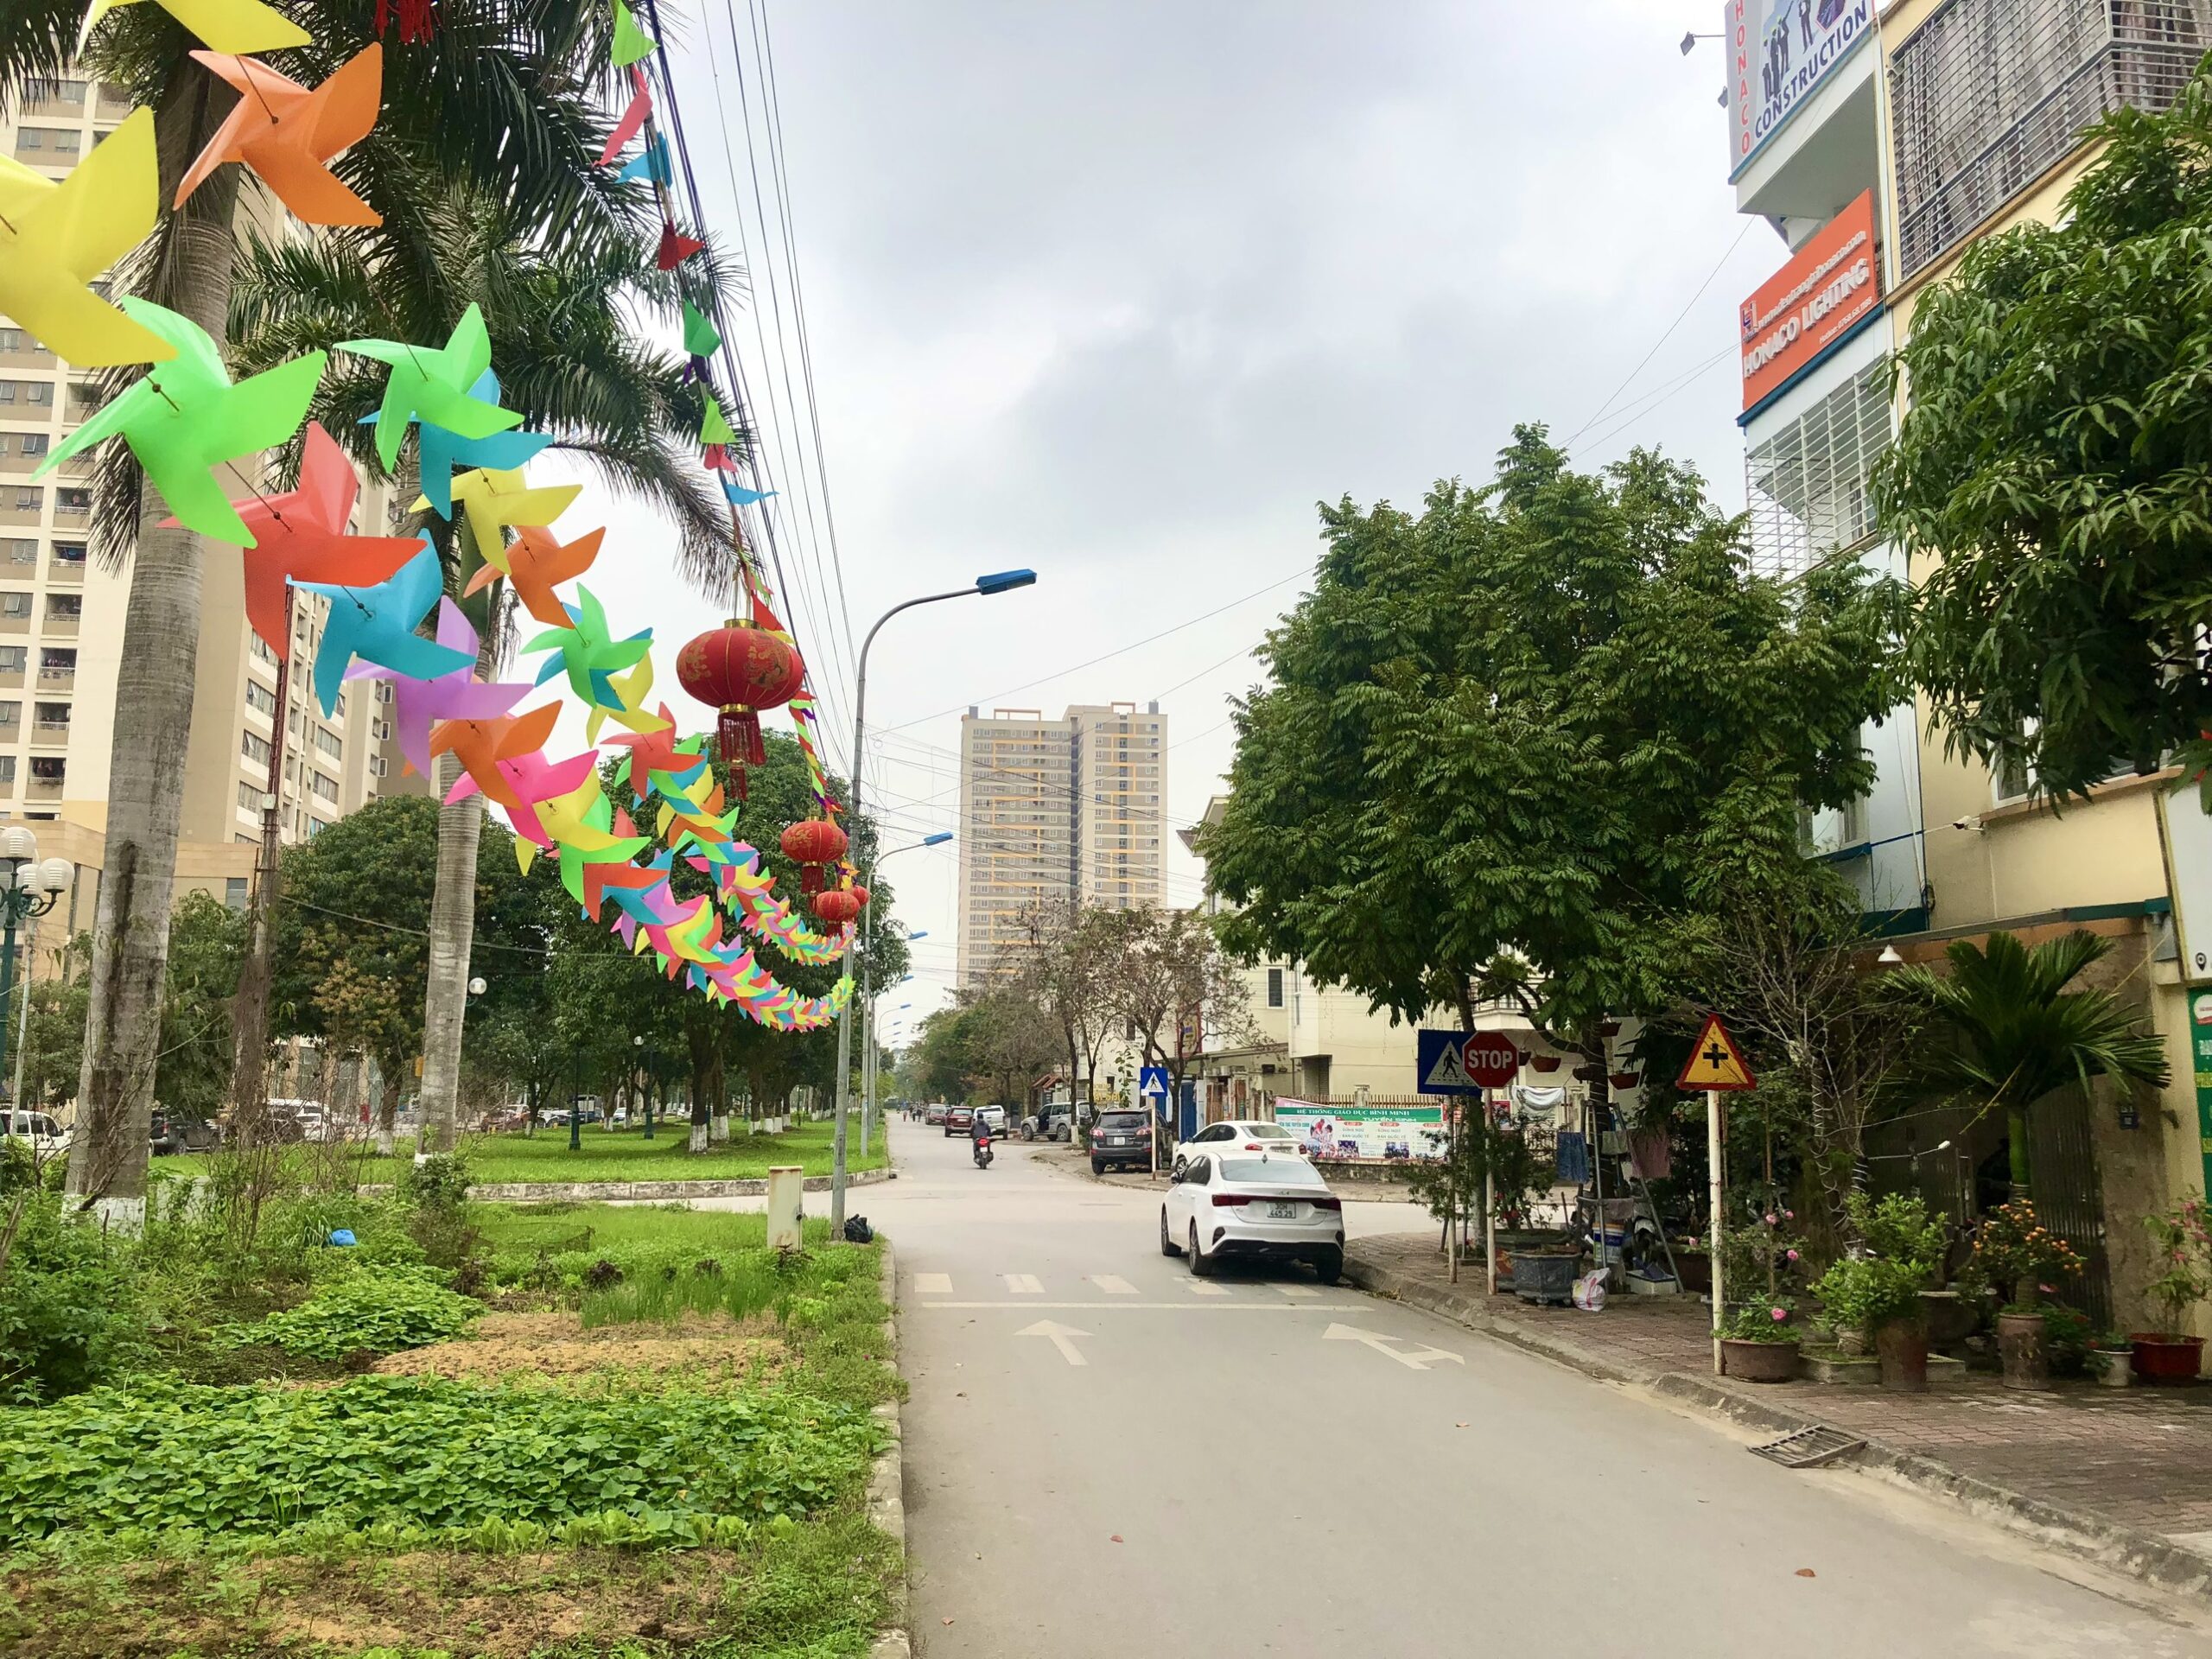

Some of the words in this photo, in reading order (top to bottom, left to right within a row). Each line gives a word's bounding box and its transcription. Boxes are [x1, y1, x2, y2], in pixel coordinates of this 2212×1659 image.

[1734, 0, 1751, 156] HONACO
[1755, 4, 1867, 138] CONSTRUCTION
[1744, 316, 1801, 378] HONACO
[1802, 257, 1870, 330] LIGHTING
[1468, 1049, 1513, 1069] STOP
